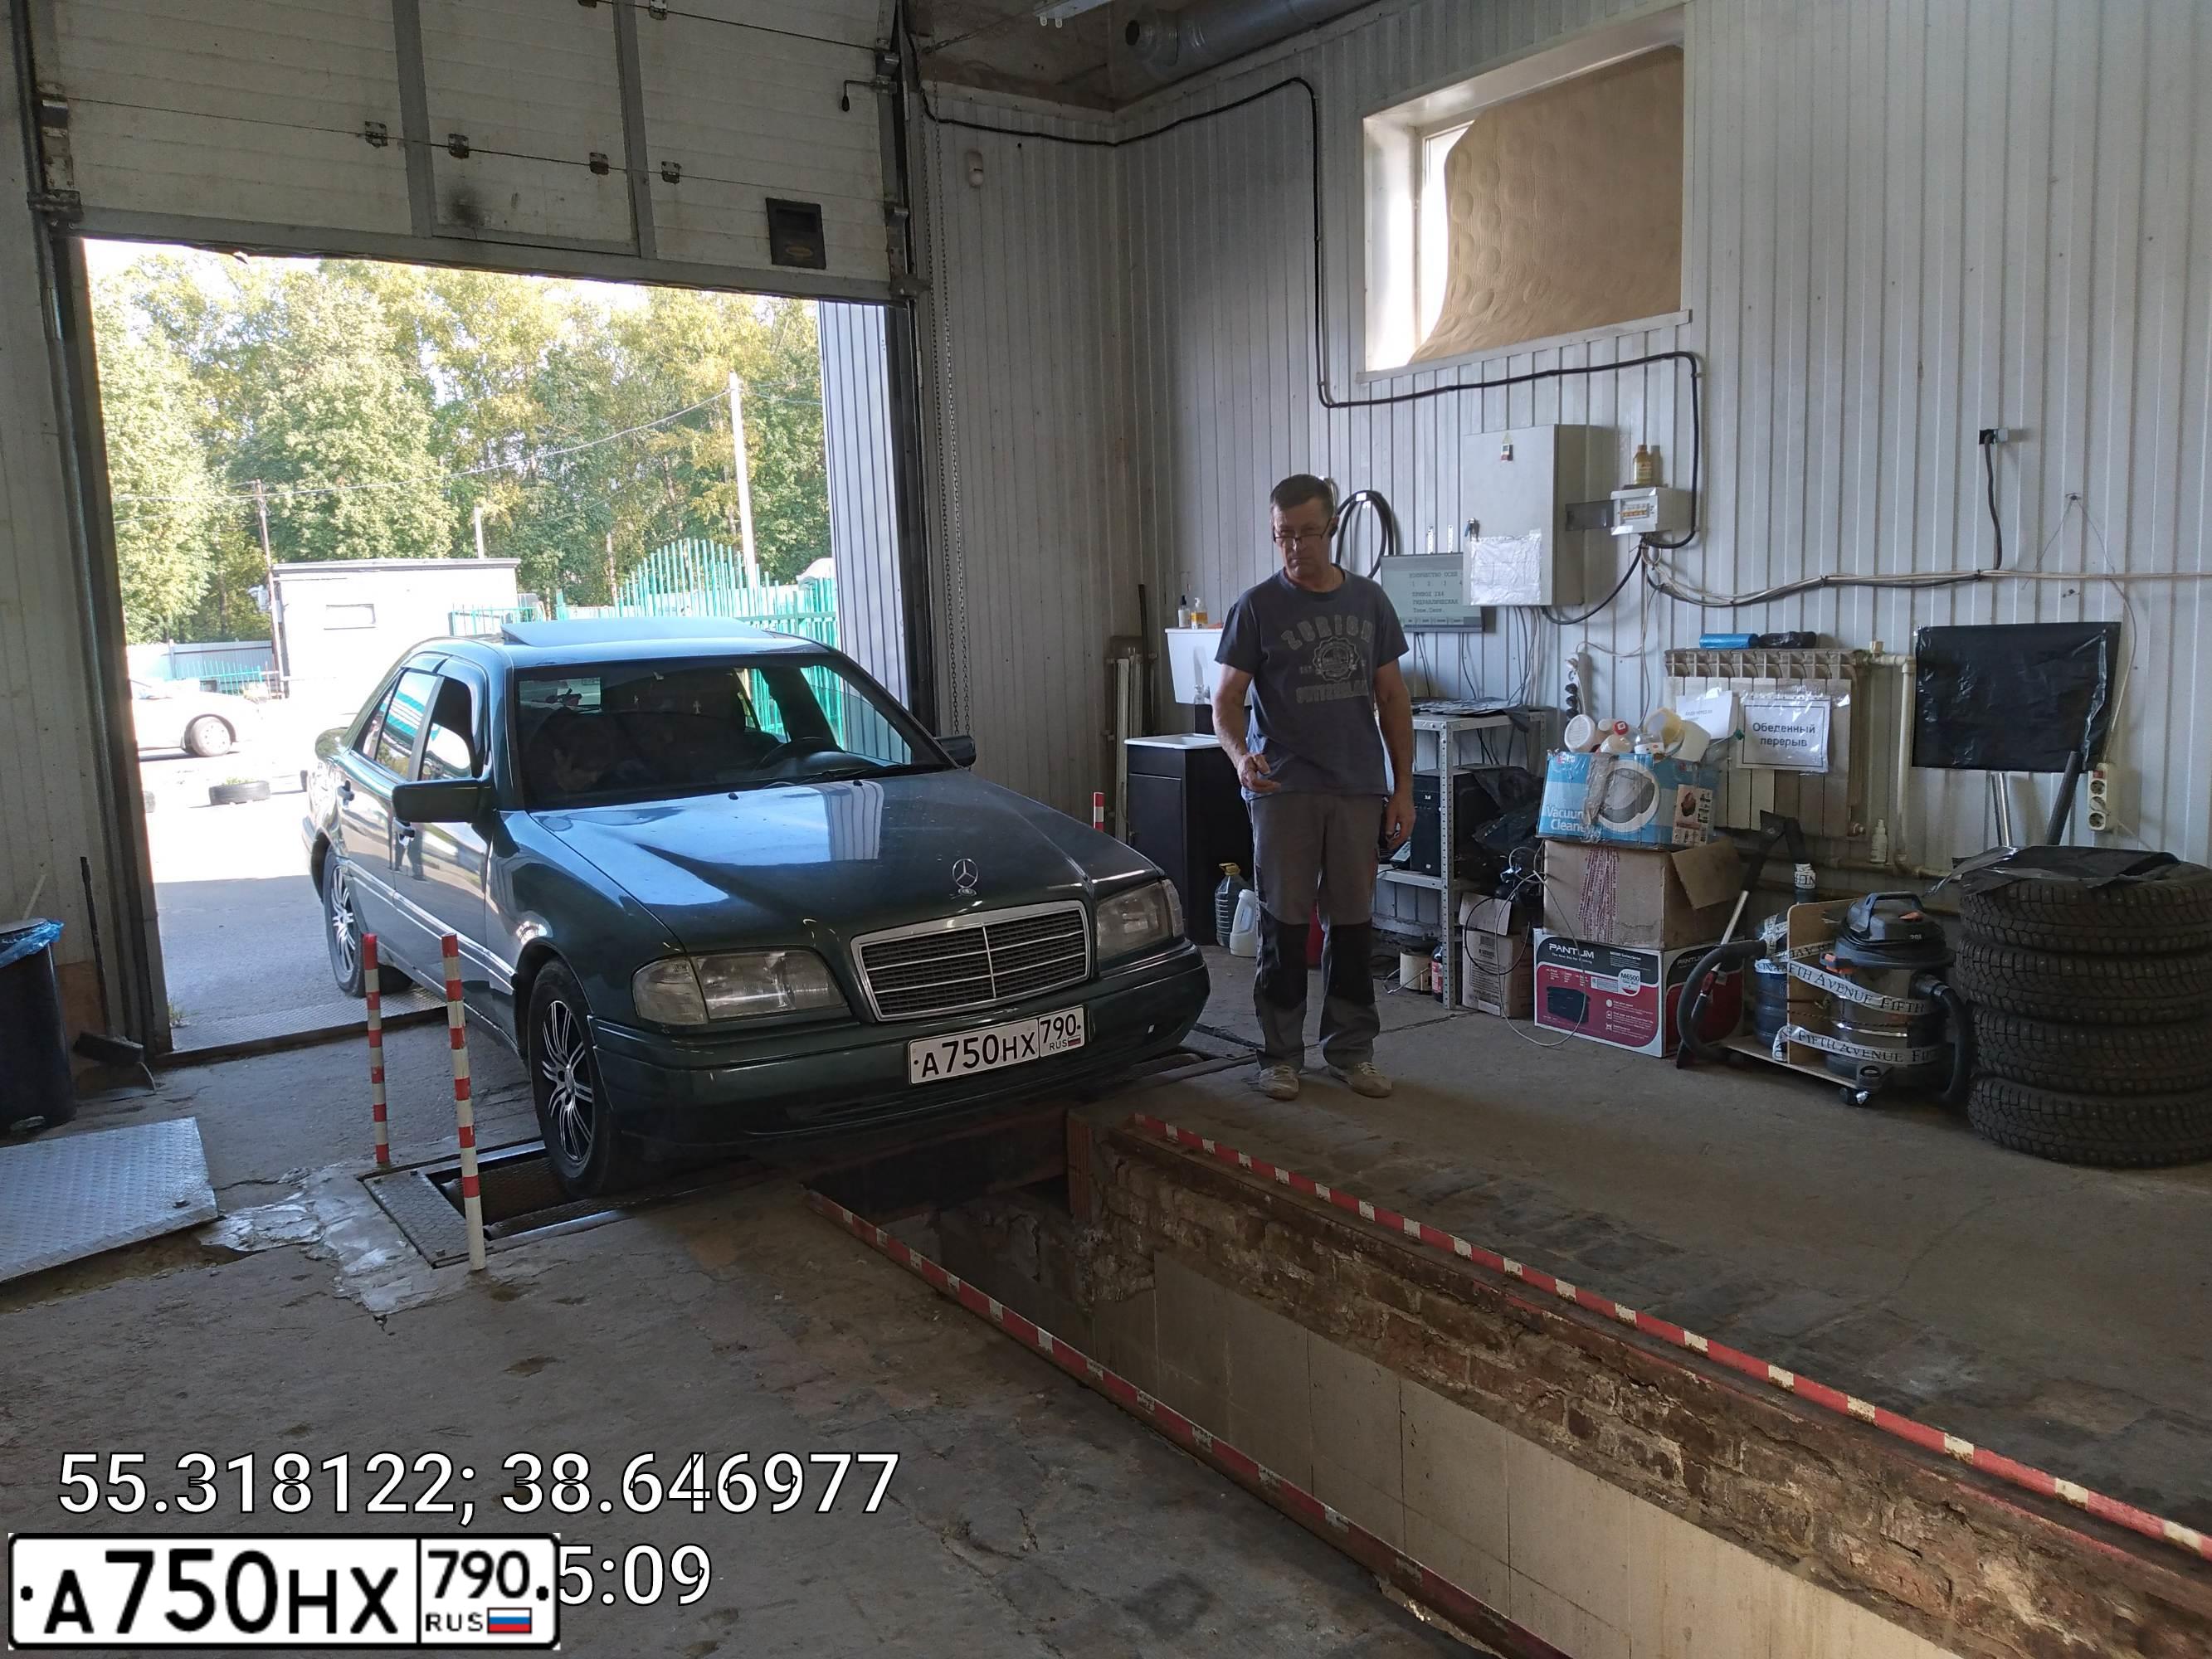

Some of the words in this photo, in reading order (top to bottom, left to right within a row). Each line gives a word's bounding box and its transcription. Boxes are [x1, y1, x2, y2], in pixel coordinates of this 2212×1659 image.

[1752, 722, 1815, 735] Обеденный
[1760, 737, 1807, 747] перерыв
[1549, 942, 1594, 959] PANTUM
[1620, 972, 1640, 982] M6500
[1814, 972, 1873, 1004] AVENUE
[1879, 997, 1925, 1014] FIFTH
[922, 1030, 1036, 1078] А750НХ
[1040, 1013, 1077, 1044] 790
[1049, 1039, 1069, 1050] RUS
[1798, 1029, 1835, 1049] FIFTH
[1839, 1045, 1903, 1062] AVENUE
